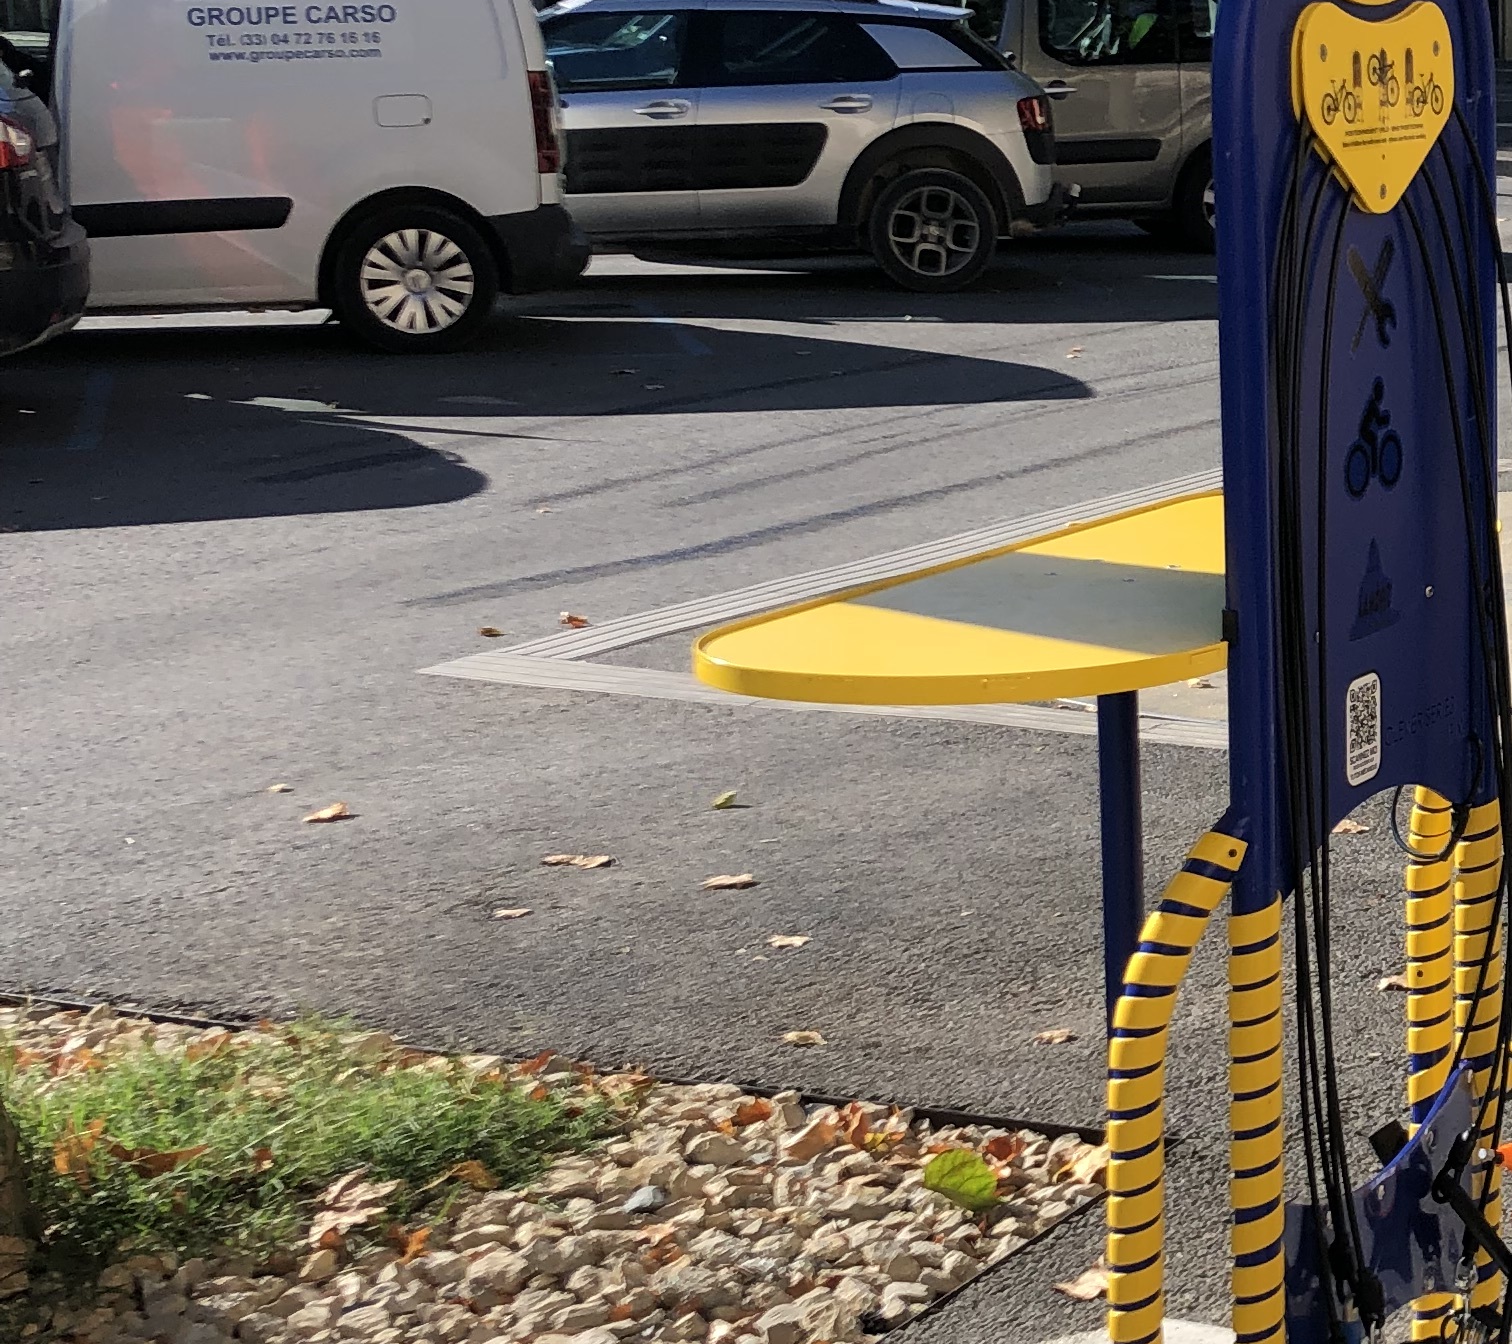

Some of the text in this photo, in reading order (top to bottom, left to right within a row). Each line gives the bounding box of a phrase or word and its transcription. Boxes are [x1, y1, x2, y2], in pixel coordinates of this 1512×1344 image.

[187, 4, 397, 27] GROUPE CARSO
[240, 33, 268, 47] (33)
[270, 33, 290, 46] 04
[293, 32, 313, 45] 72
[208, 48, 383, 63] www.groupecarso.com
